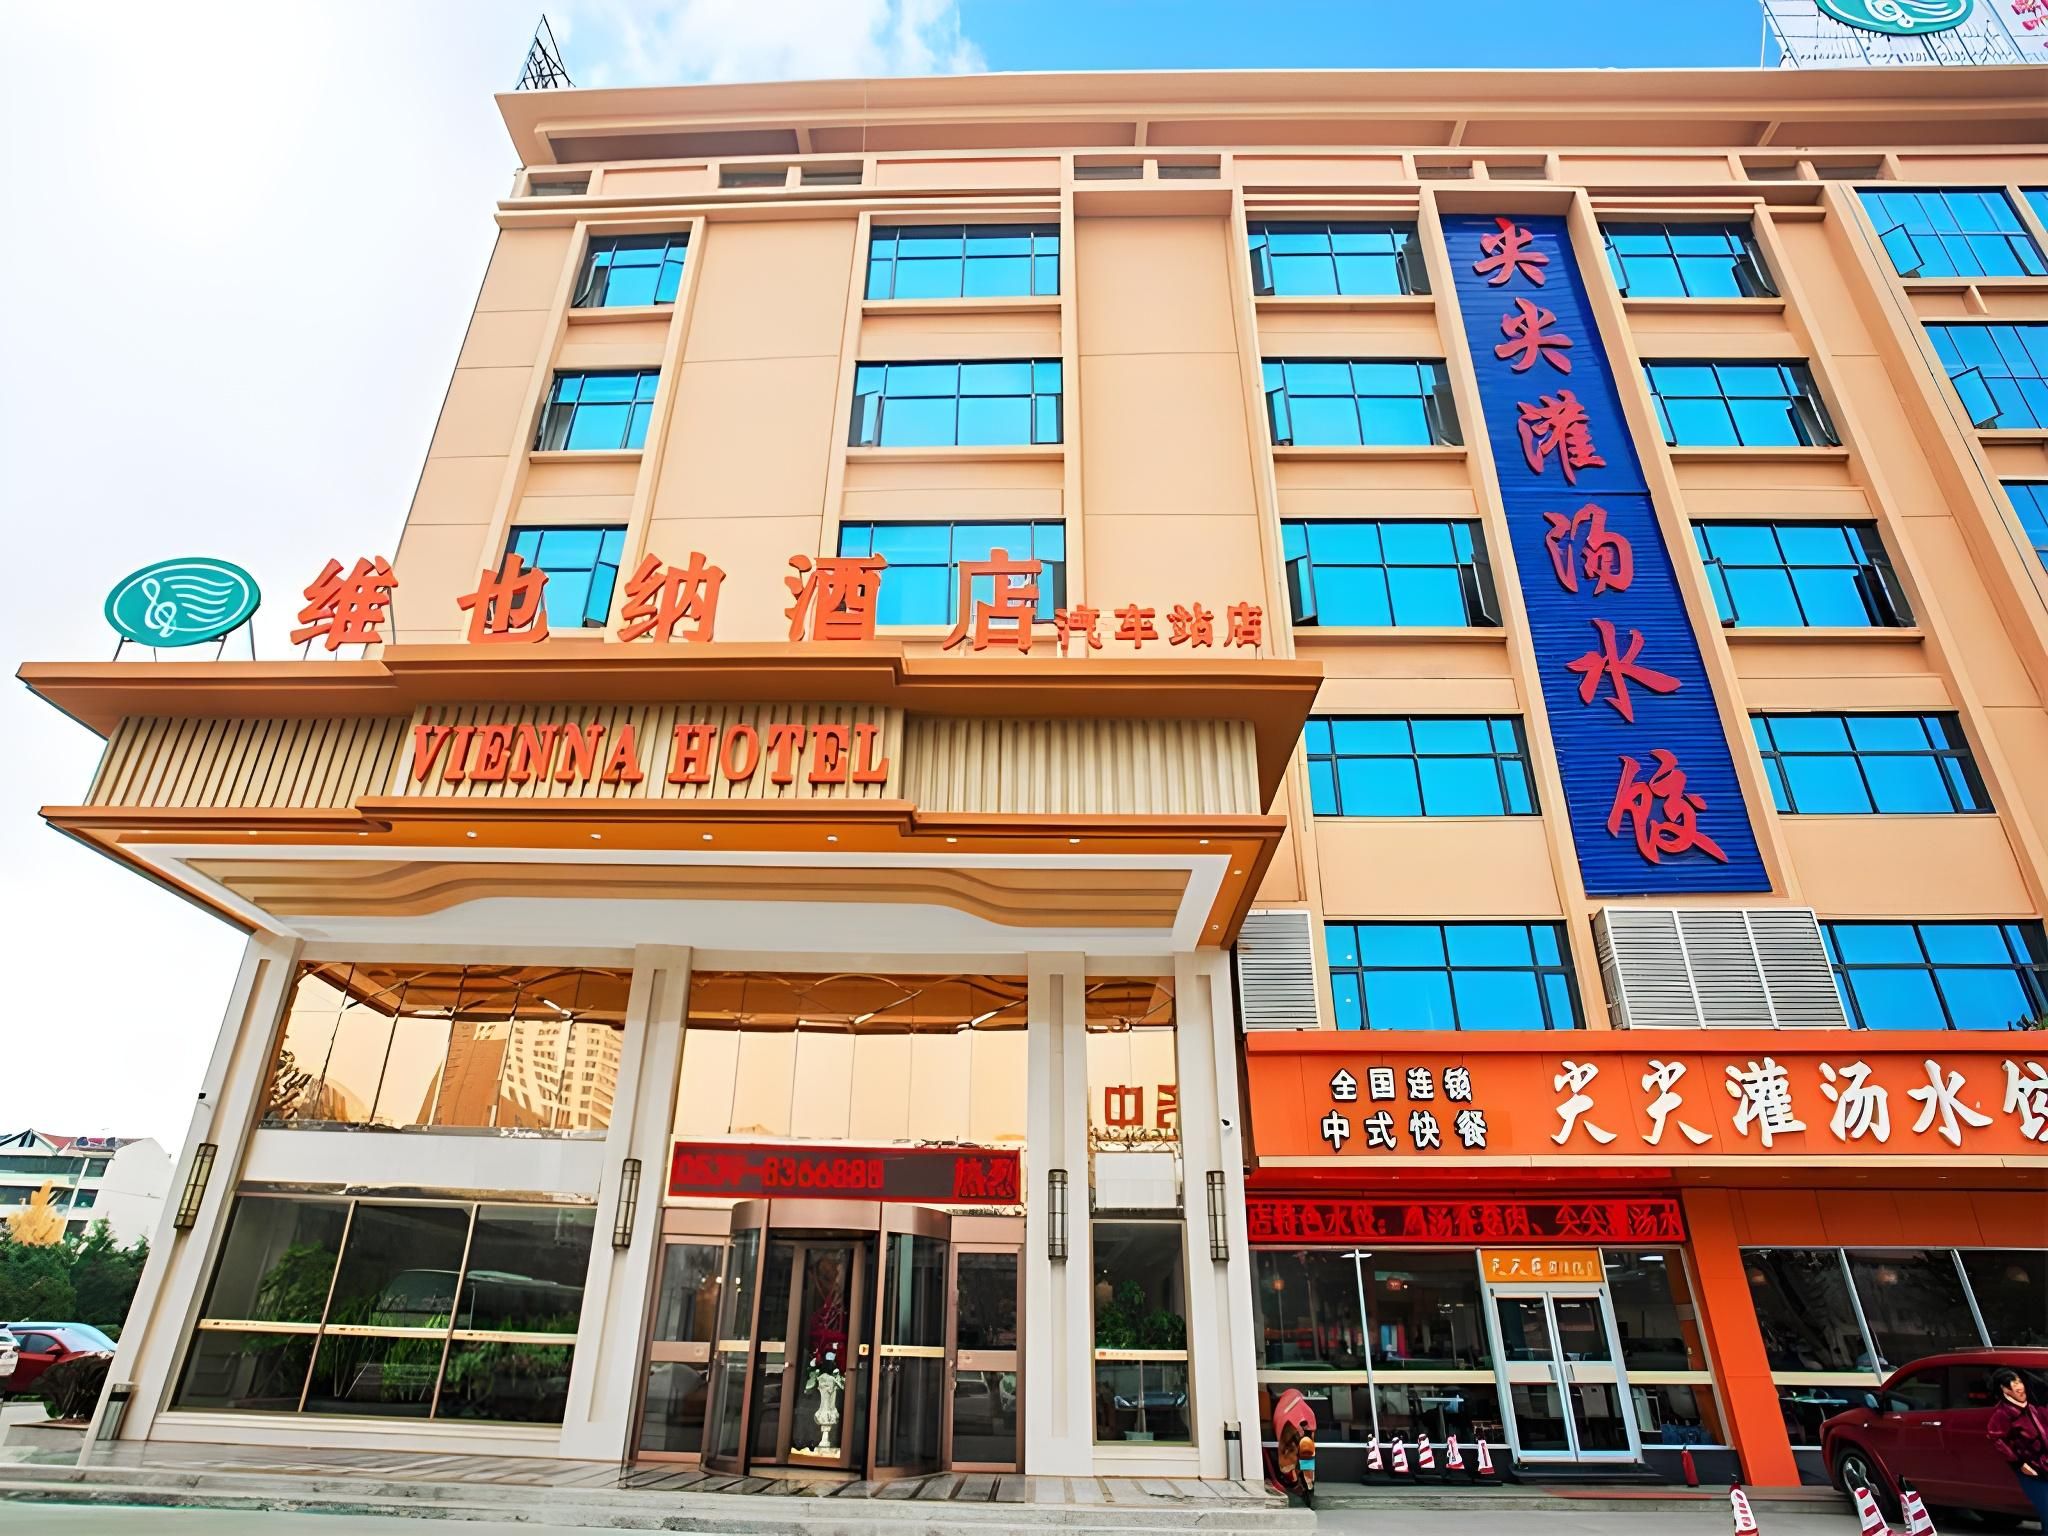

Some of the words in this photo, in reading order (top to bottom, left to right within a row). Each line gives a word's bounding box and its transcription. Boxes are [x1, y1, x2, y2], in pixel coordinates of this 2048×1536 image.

[1473, 217, 1729, 864] 尖尖灌汤水饺
[289, 548, 1043, 655] 维也纳酒店
[1055, 601, 1263, 651] 汽车站店
[412, 723, 645, 785] VIENNA
[667, 723, 890, 785] HOTEL
[1329, 1066, 1473, 1104] 全国连锁
[1320, 1108, 1489, 1153] 中式快餐
